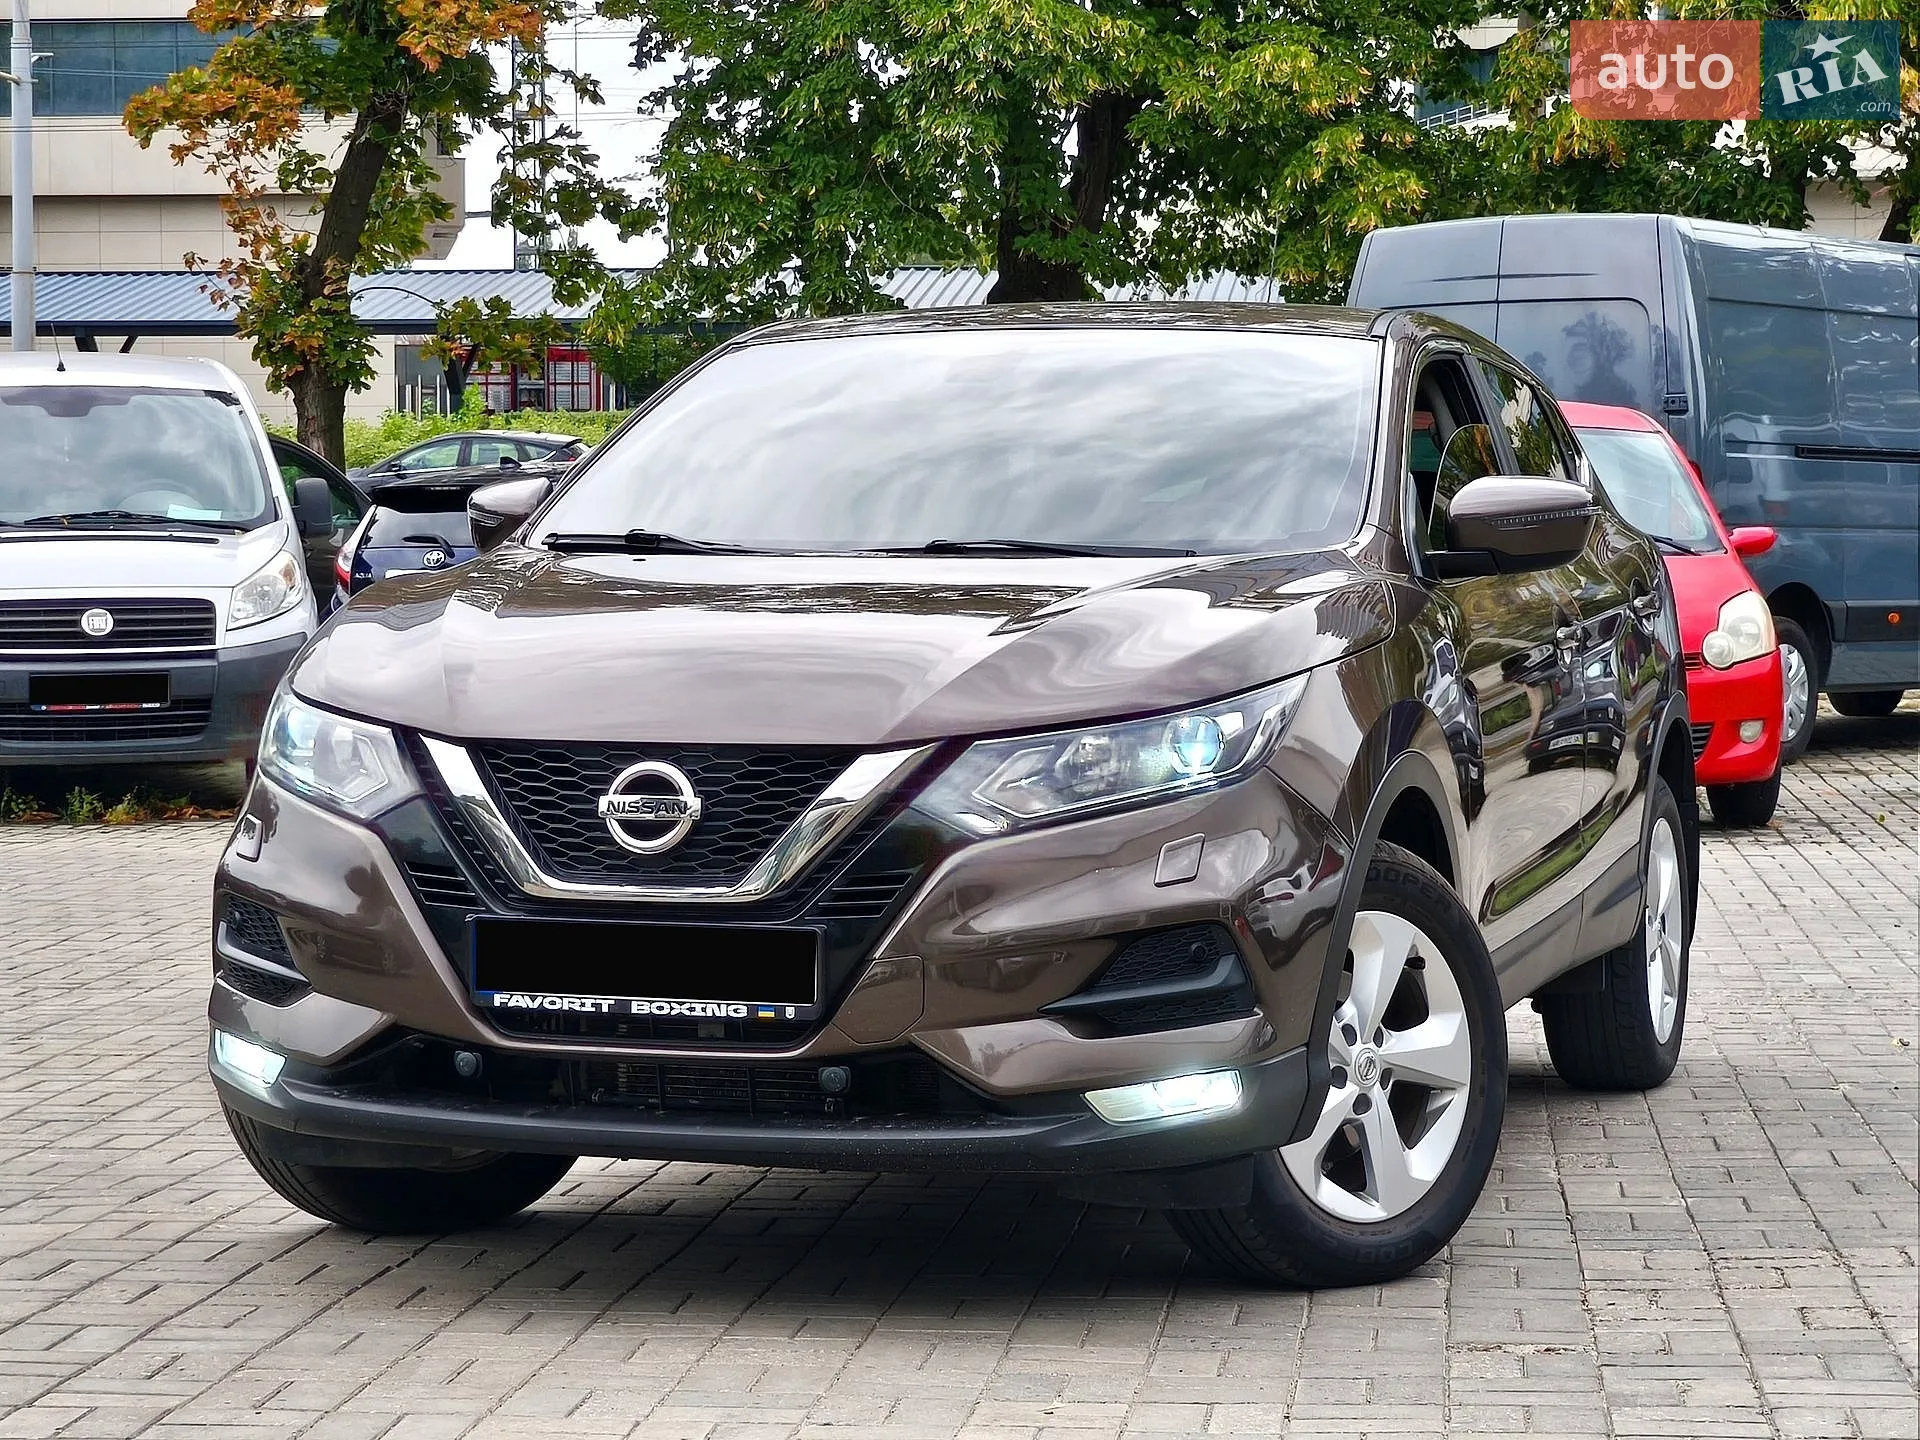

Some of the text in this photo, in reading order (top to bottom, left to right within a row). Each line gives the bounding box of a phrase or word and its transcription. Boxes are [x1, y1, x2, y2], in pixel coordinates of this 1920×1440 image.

[606, 800, 688, 816] NISSAN
[493, 993, 749, 1019] FAVORIT BOXING
